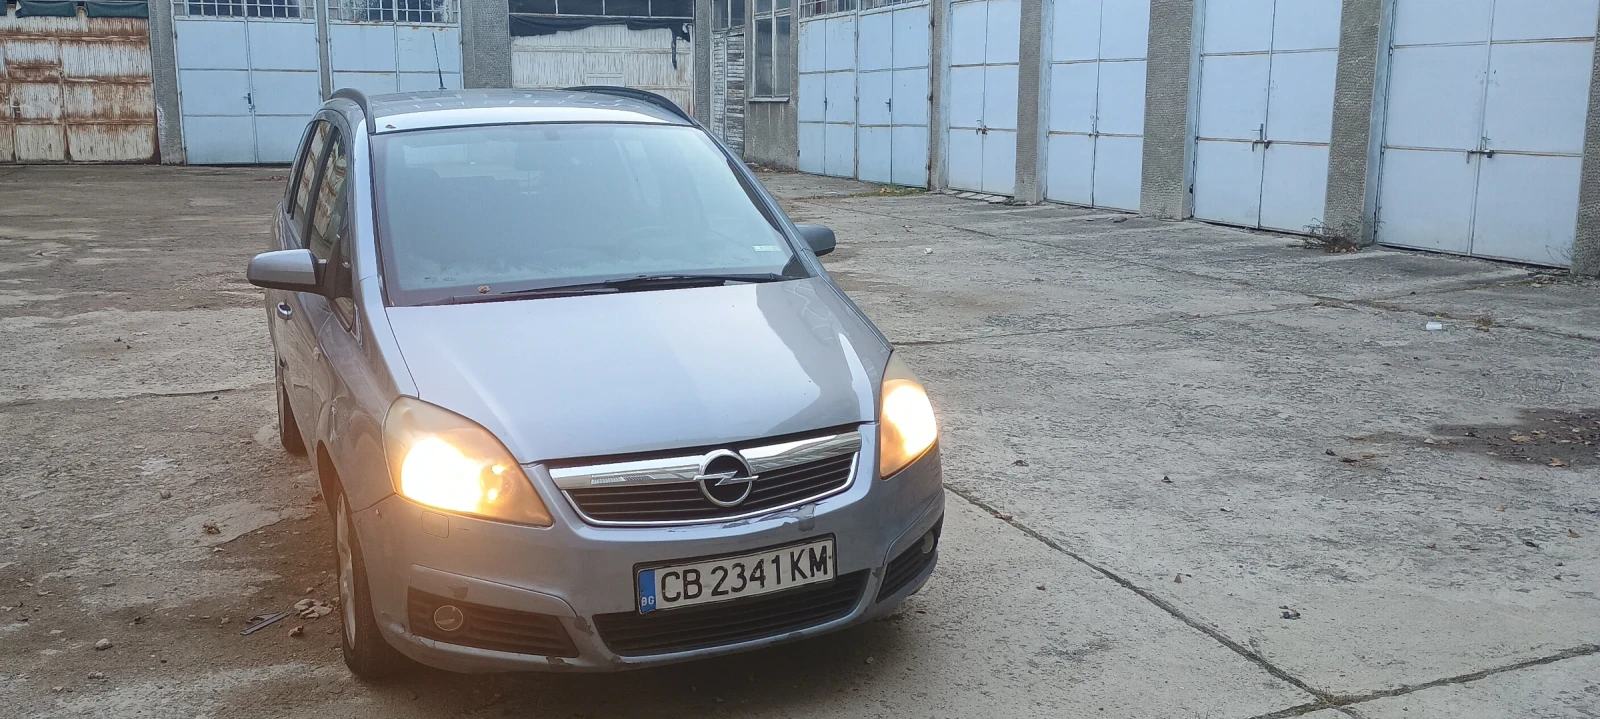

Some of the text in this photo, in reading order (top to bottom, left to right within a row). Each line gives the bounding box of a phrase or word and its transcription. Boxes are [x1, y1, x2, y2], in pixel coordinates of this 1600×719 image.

[661, 545, 828, 602] CB 2341 KM
[641, 596, 655, 606] BG
